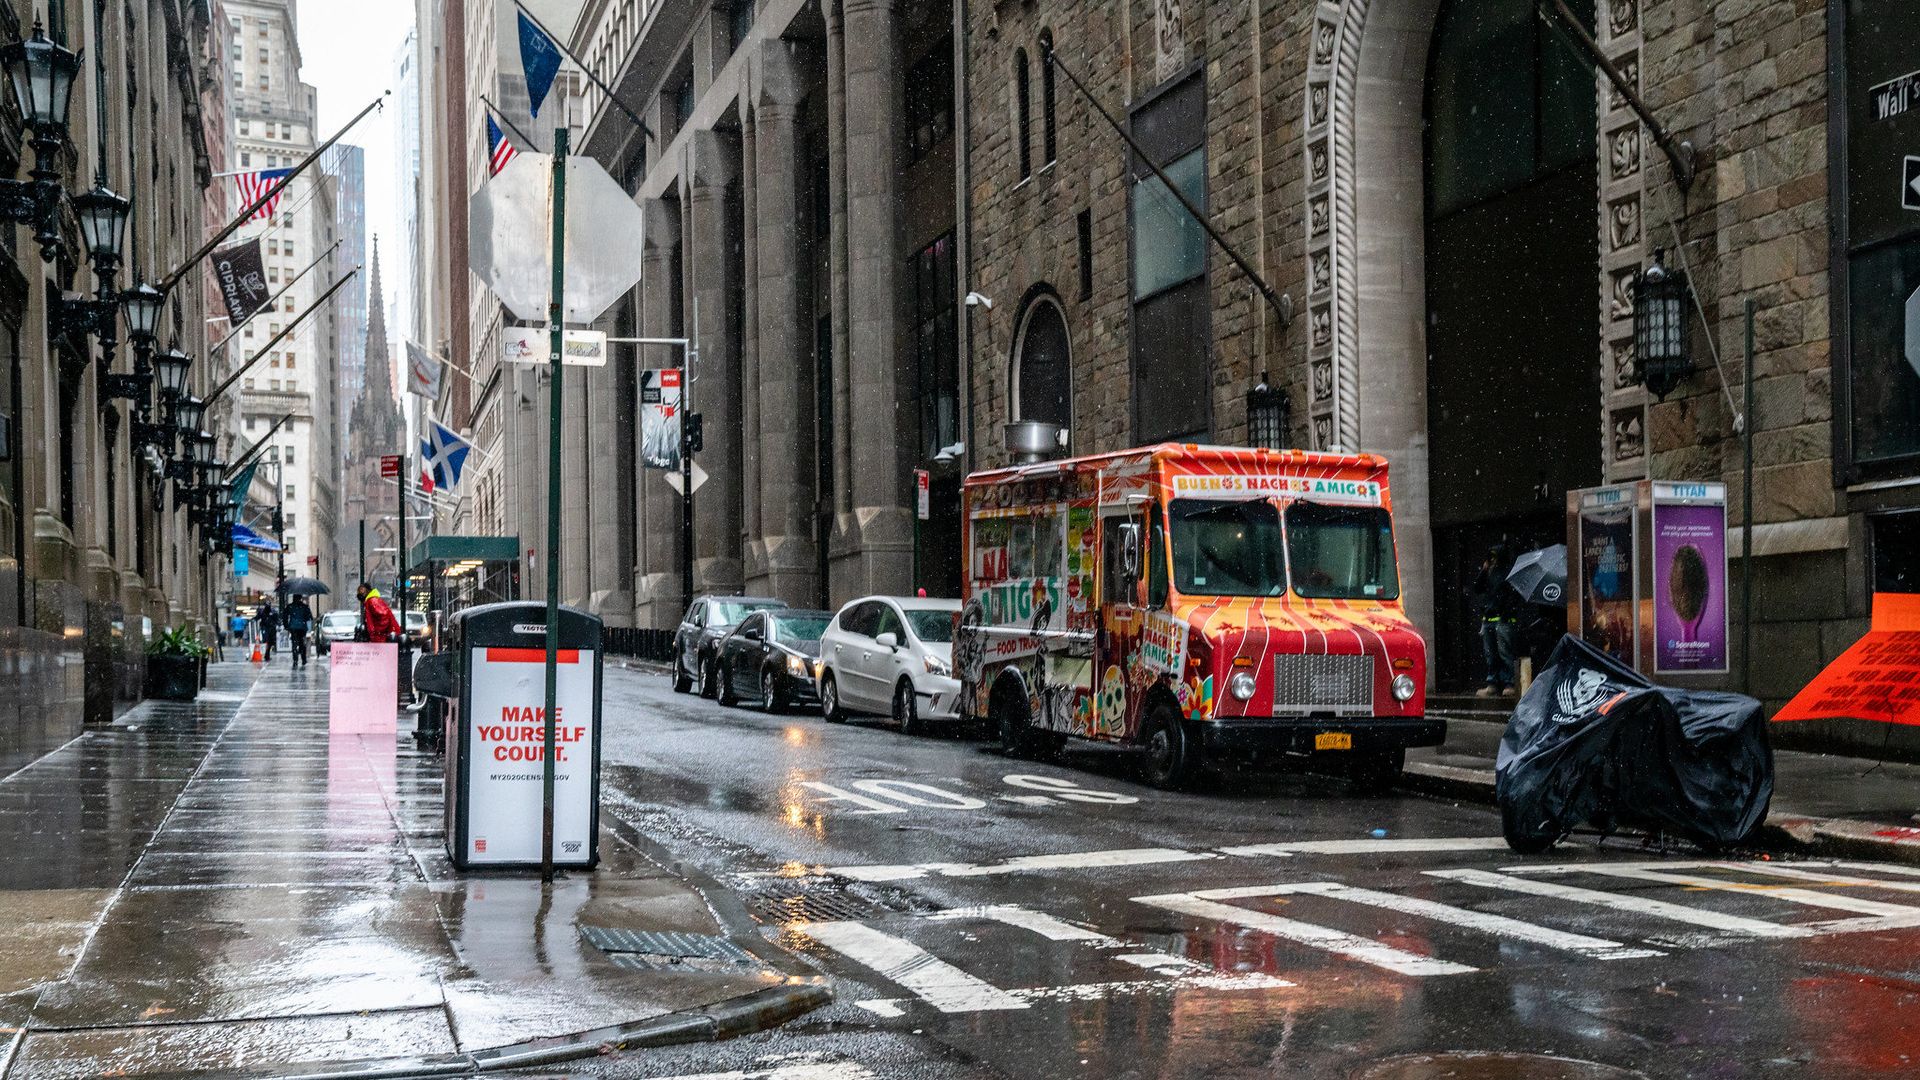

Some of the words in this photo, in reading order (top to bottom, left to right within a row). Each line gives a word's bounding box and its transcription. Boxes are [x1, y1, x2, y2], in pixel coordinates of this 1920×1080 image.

[1878, 86, 1908, 120] Wall
[1177, 477, 1243, 491] BUENOS
[1246, 479, 1311, 493] NACHOS
[1315, 480, 1378, 498] AMIGOS
[1671, 484, 1706, 497] TITAN
[1596, 490, 1621, 503] TITAN
[997, 639, 1017, 655] FOOD
[502, 706, 563, 723] MAKE
[477, 726, 586, 742] YOURSELF
